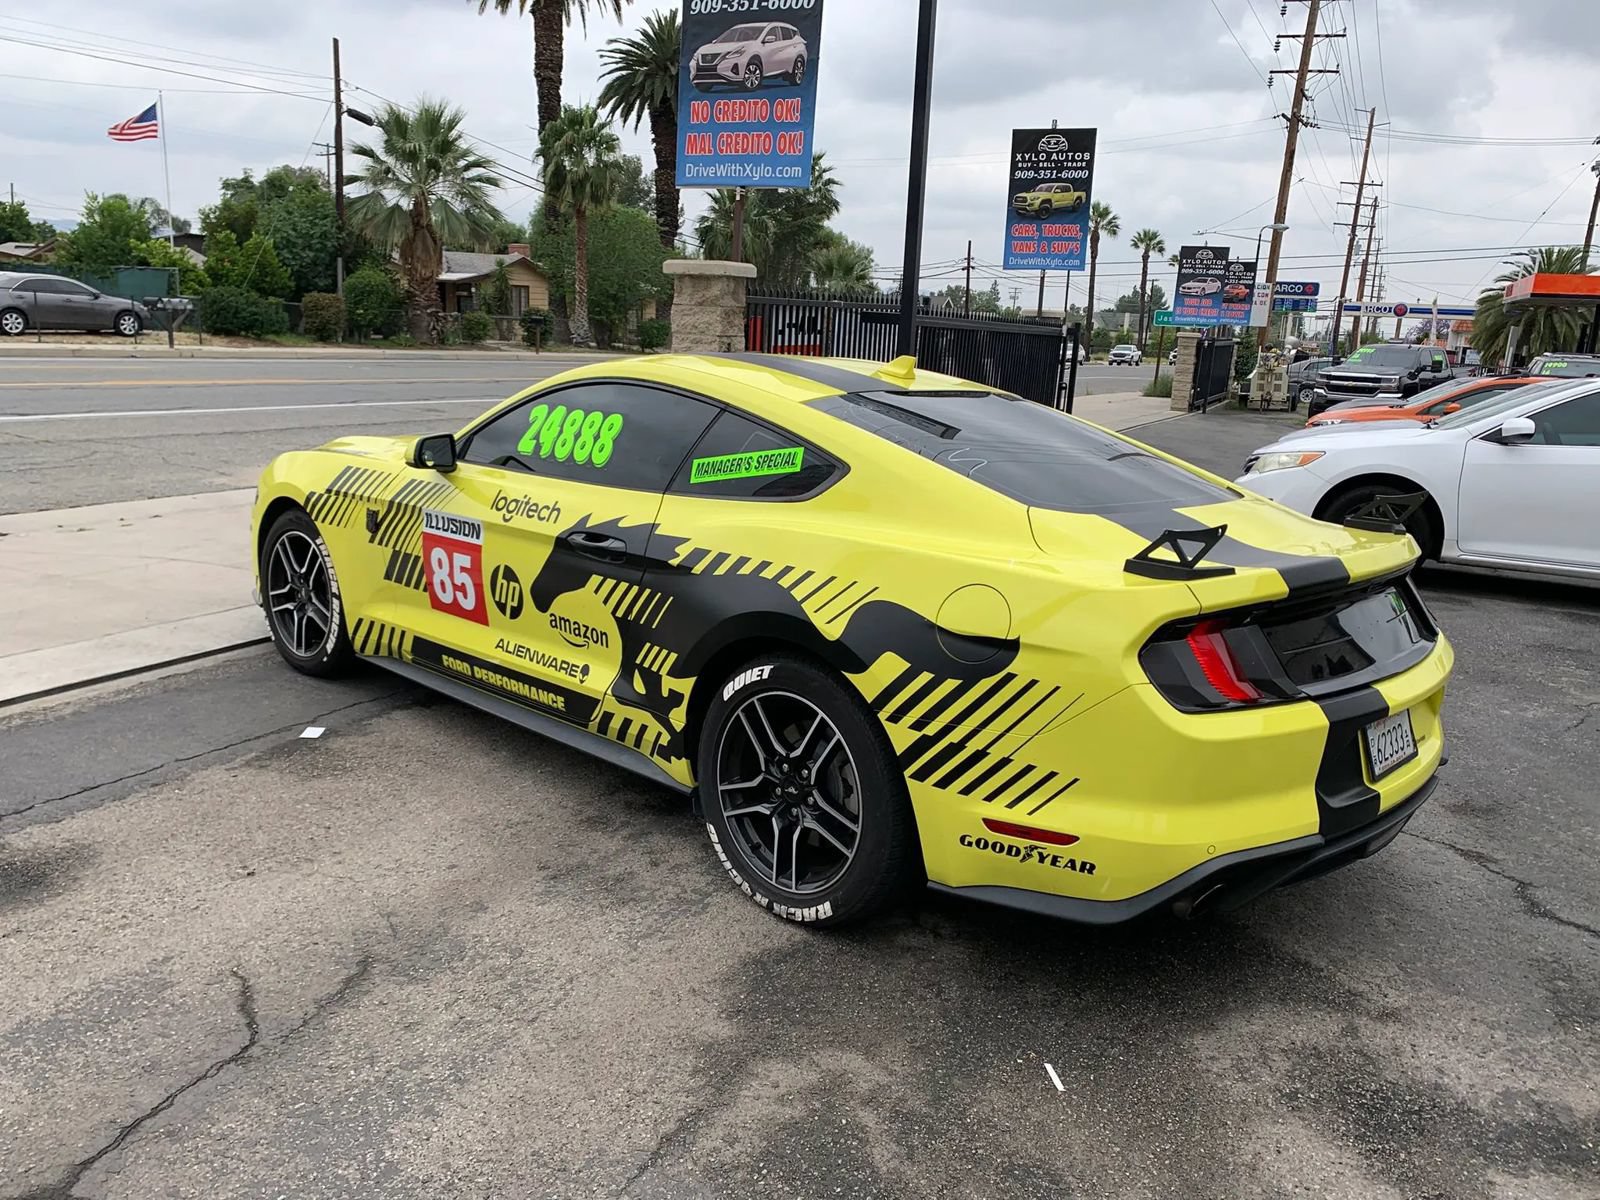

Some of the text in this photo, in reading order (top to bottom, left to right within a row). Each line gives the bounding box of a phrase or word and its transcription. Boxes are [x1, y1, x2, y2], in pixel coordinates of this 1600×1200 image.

[690, 0, 815, 15] 909-351-6000
[690, 98, 800, 123] NO CREDITO OK!
[685, 131, 803, 155] MAL CREDITO OK!
[1015, 152, 1090, 161] XYLO AUTOS
[685, 162, 802, 180] DriveWithXylo.com
[1014, 169, 1089, 179] 909-351-6000
[1011, 224, 1083, 239] CARS, TRUCKS,
[1012, 241, 1037, 254] VANS
[1040, 241, 1048, 254] &
[1009, 256, 1080, 267] DriveWithXylo.com
[1275, 284, 1303, 293] ARCO
[517, 404, 623, 468] 24888
[694, 450, 797, 478] MANAGER'S SPECIAL
[490, 490, 561, 524] logitech
[424, 512, 481, 540] ILLUSION
[430, 547, 475, 610] 85
[494, 565, 520, 618] hp
[549, 613, 609, 648] amazon
[442, 655, 471, 676] FORD
[495, 638, 580, 679] ALIENWARE
[723, 664, 774, 701] QUIET
[1377, 723, 1405, 765] 62333
[959, 834, 1097, 875] GOODYEAR
